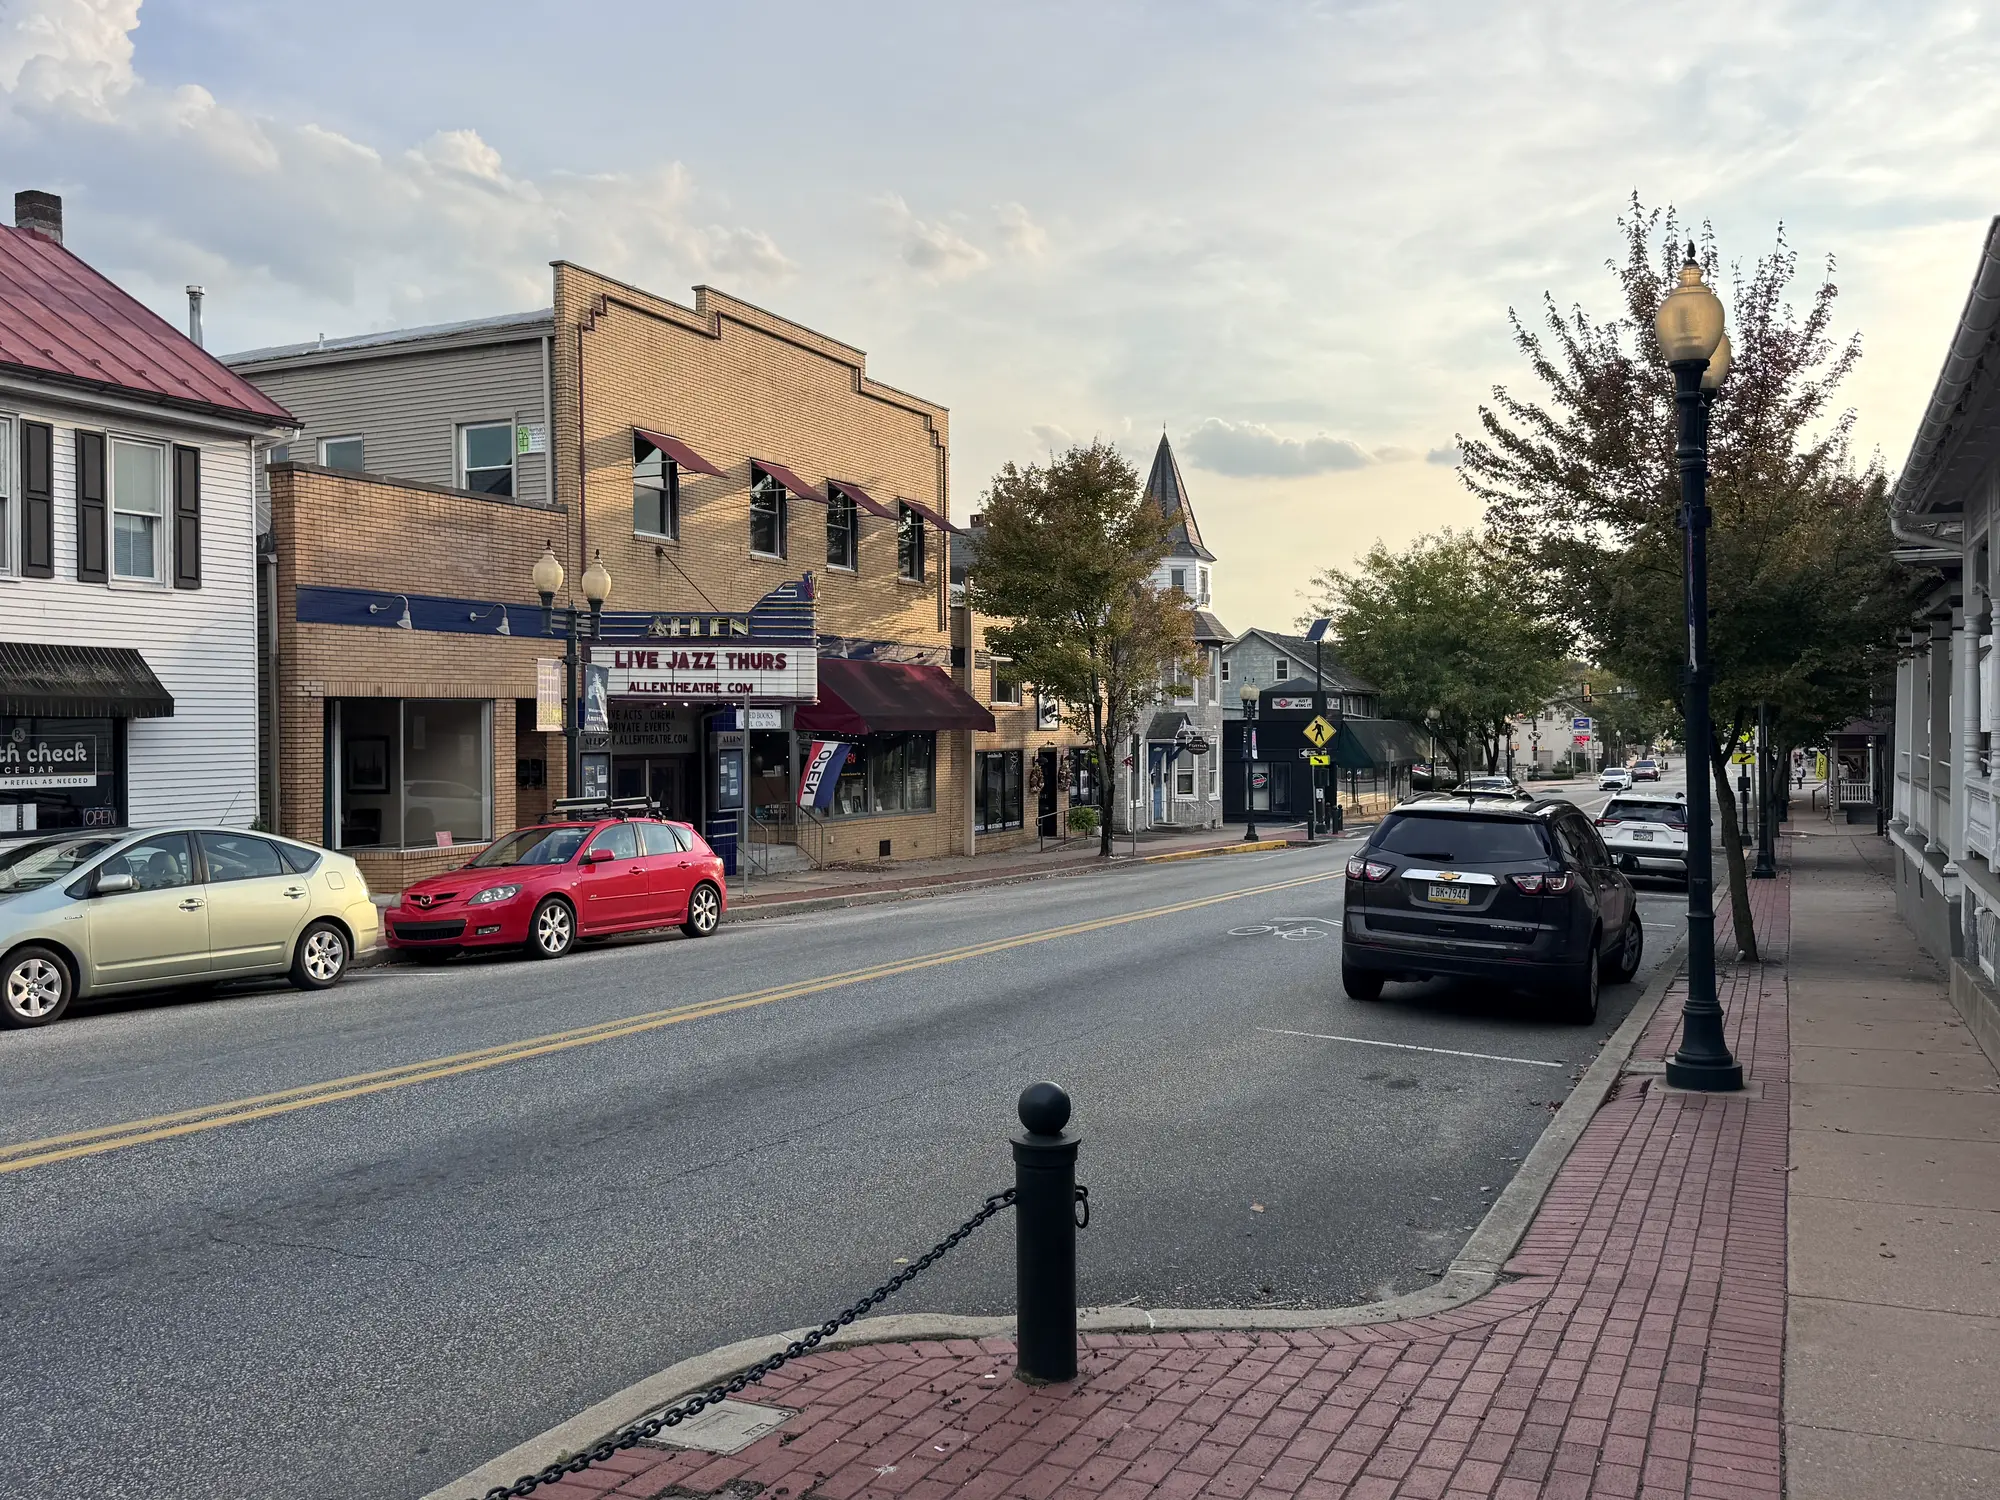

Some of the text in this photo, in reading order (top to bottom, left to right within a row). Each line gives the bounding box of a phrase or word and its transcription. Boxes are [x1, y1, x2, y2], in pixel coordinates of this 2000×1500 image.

[647, 616, 749, 637] ALLEN
[615, 651, 787, 670] LIVE JAZZ THURS
[608, 709, 620, 720] IVE
[624, 709, 643, 720] ACTS
[650, 709, 676, 720] CINEMA
[757, 711, 774, 719] BOOKS
[610, 722, 671, 732] PRIVATE EVENTS
[27, 742, 87, 762] check
[29, 766, 54, 774] BAR
[57, 777, 88, 785] NEEDED
[85, 810, 117, 826] OPEN
